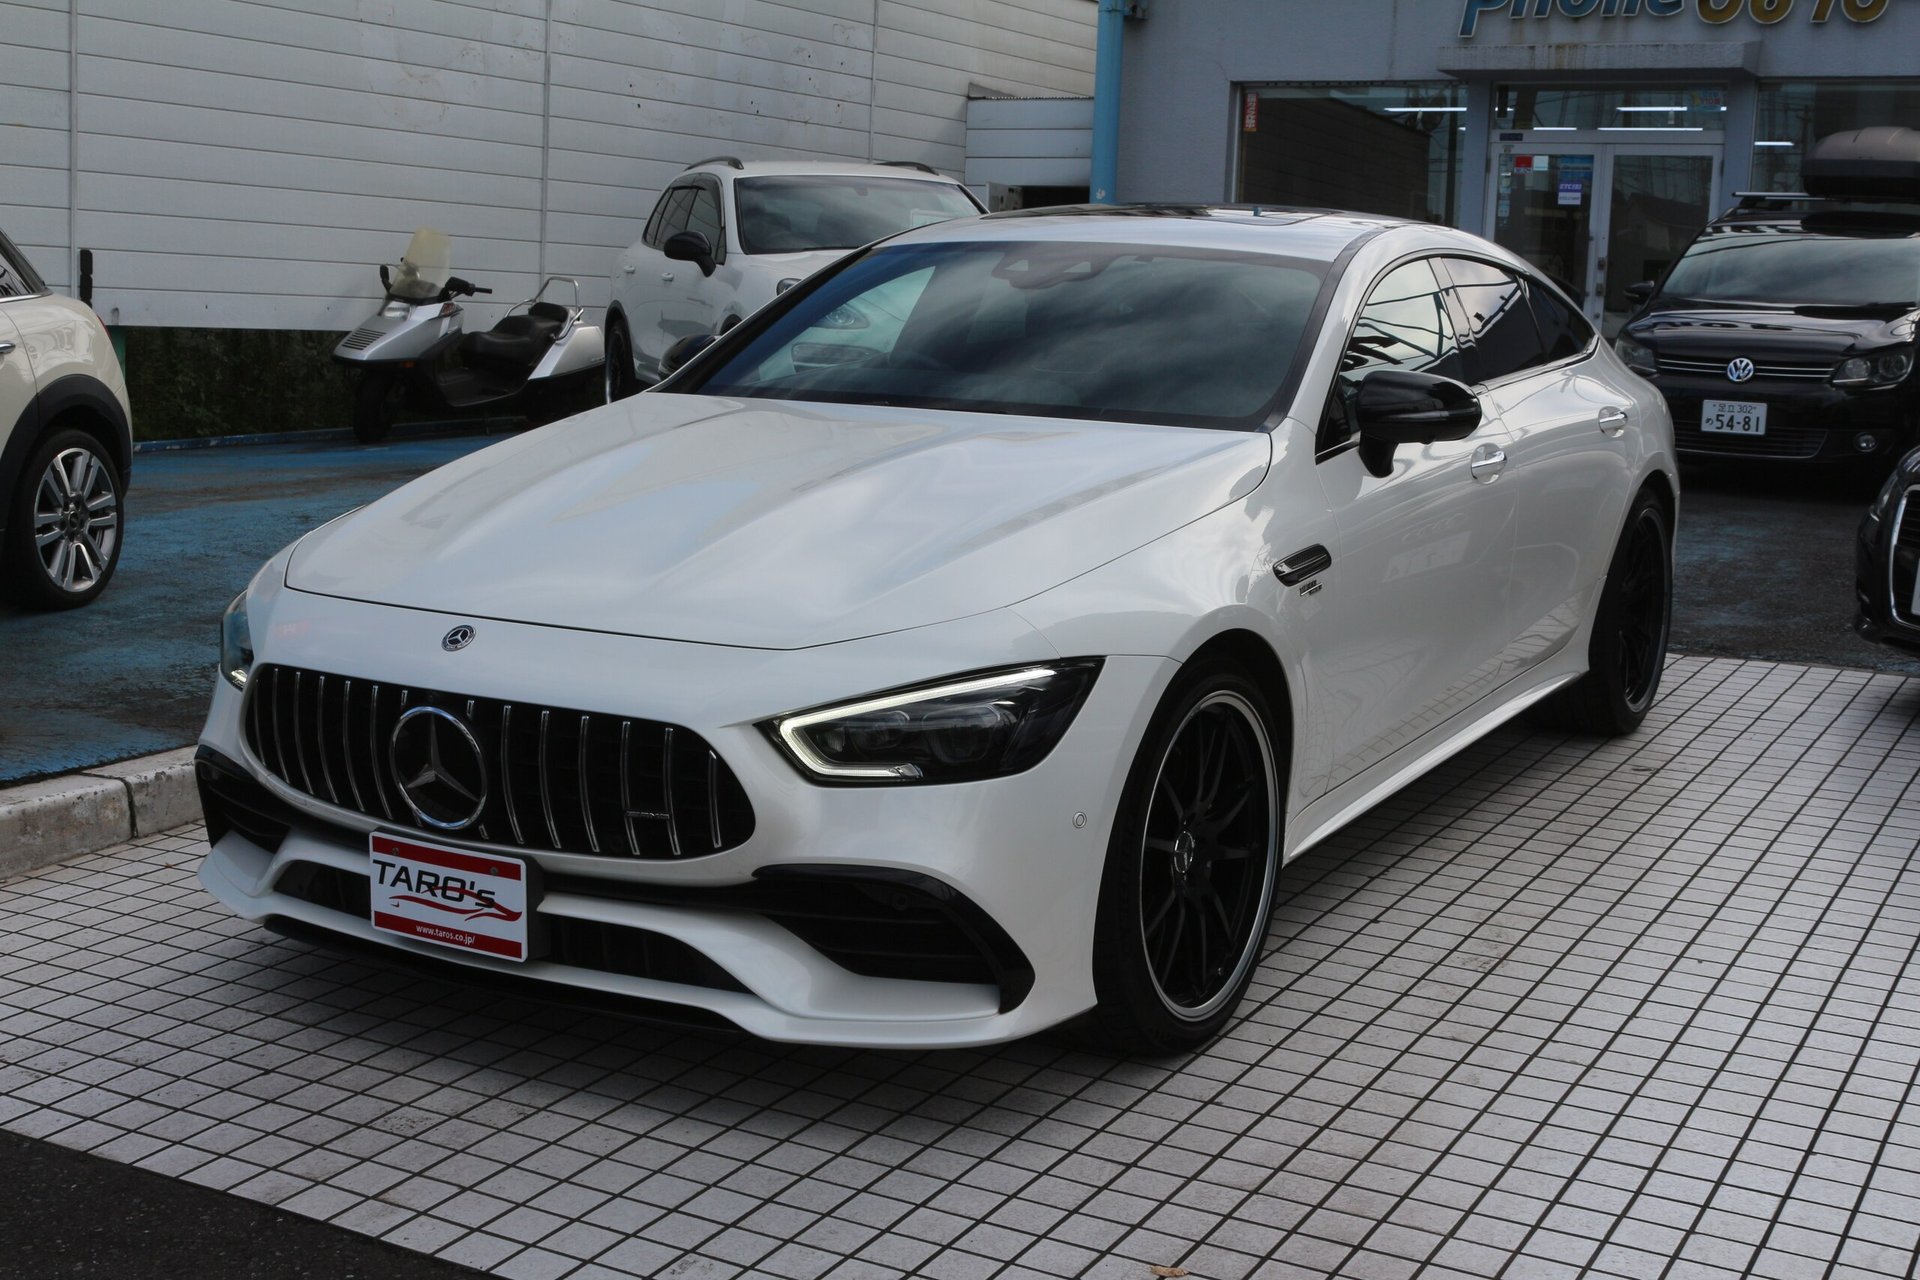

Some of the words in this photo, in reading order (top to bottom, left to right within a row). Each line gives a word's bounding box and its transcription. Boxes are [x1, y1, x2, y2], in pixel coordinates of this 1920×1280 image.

[1715, 413, 1760, 433] 54-81
[372, 859, 496, 909] TARO's
[415, 925, 475, 945] www.taros.co.jp/
